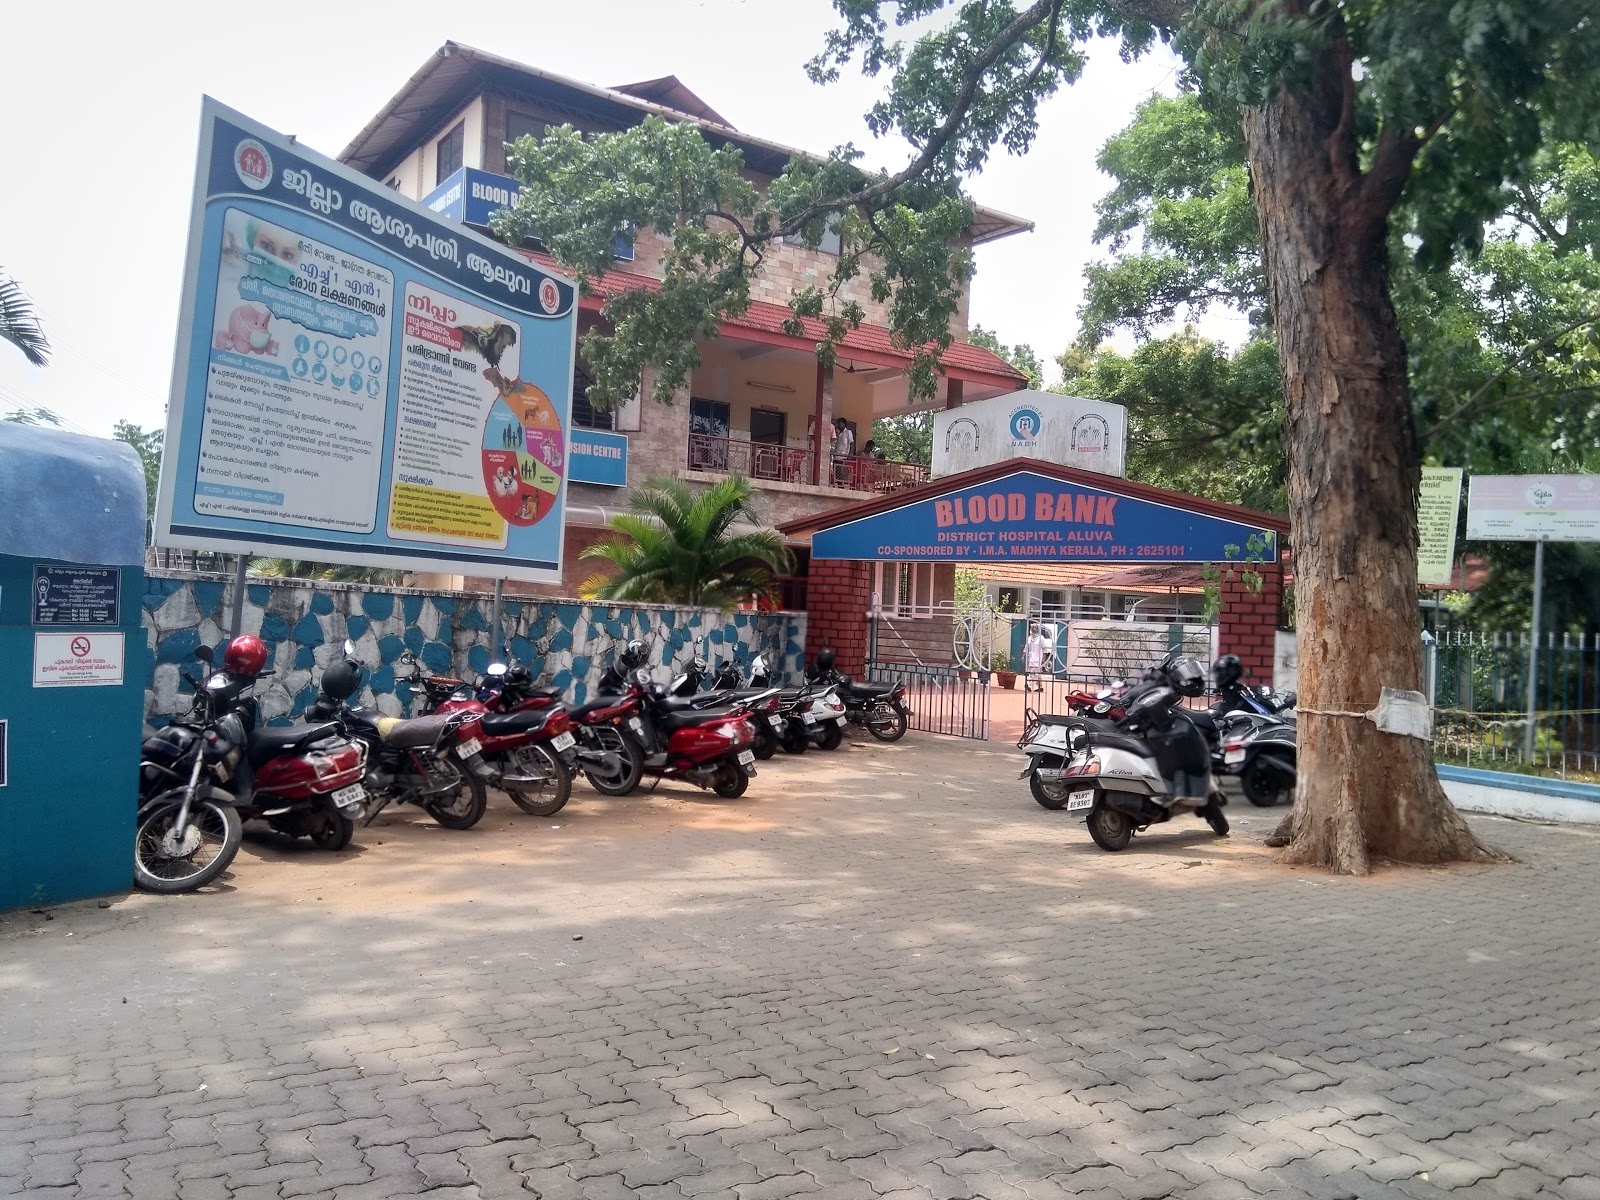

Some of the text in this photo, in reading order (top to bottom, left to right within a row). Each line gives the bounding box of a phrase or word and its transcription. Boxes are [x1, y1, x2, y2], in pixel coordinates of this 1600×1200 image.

[472, 182, 509, 207] BLOOD
[279, 159, 531, 301] ജില്ലാ ആശുപത്രി, ആലുവ
[298, 253, 380, 301] എച്ച് 1 എൻ 1
[287, 271, 386, 319] രോഗ ലക്ഷണങ്ങൾ
[407, 288, 457, 327] നിപ്പാ
[406, 312, 450, 339] സൂക്ഷിക്കാം
[406, 323, 420, 337] ഈ
[405, 339, 450, 367] പരിഭ്രാന്തി
[451, 356, 477, 374] വേണ്ട
[593, 444, 622, 459] CENTRE
[934, 493, 1118, 528] BLOOD BANK
[877, 545, 954, 556] CO-SPONSORED
[956, 545, 970, 555] BY
[979, 545, 1008, 556] I.M.A.
[1011, 545, 1057, 556] MADHYA
[1059, 545, 1108, 557] KERALA,
[1111, 545, 1127, 556] PH
[1136, 545, 1185, 556] 2625101
[937, 531, 1113, 542] DISTRICT HOSPITAL ALUVA
